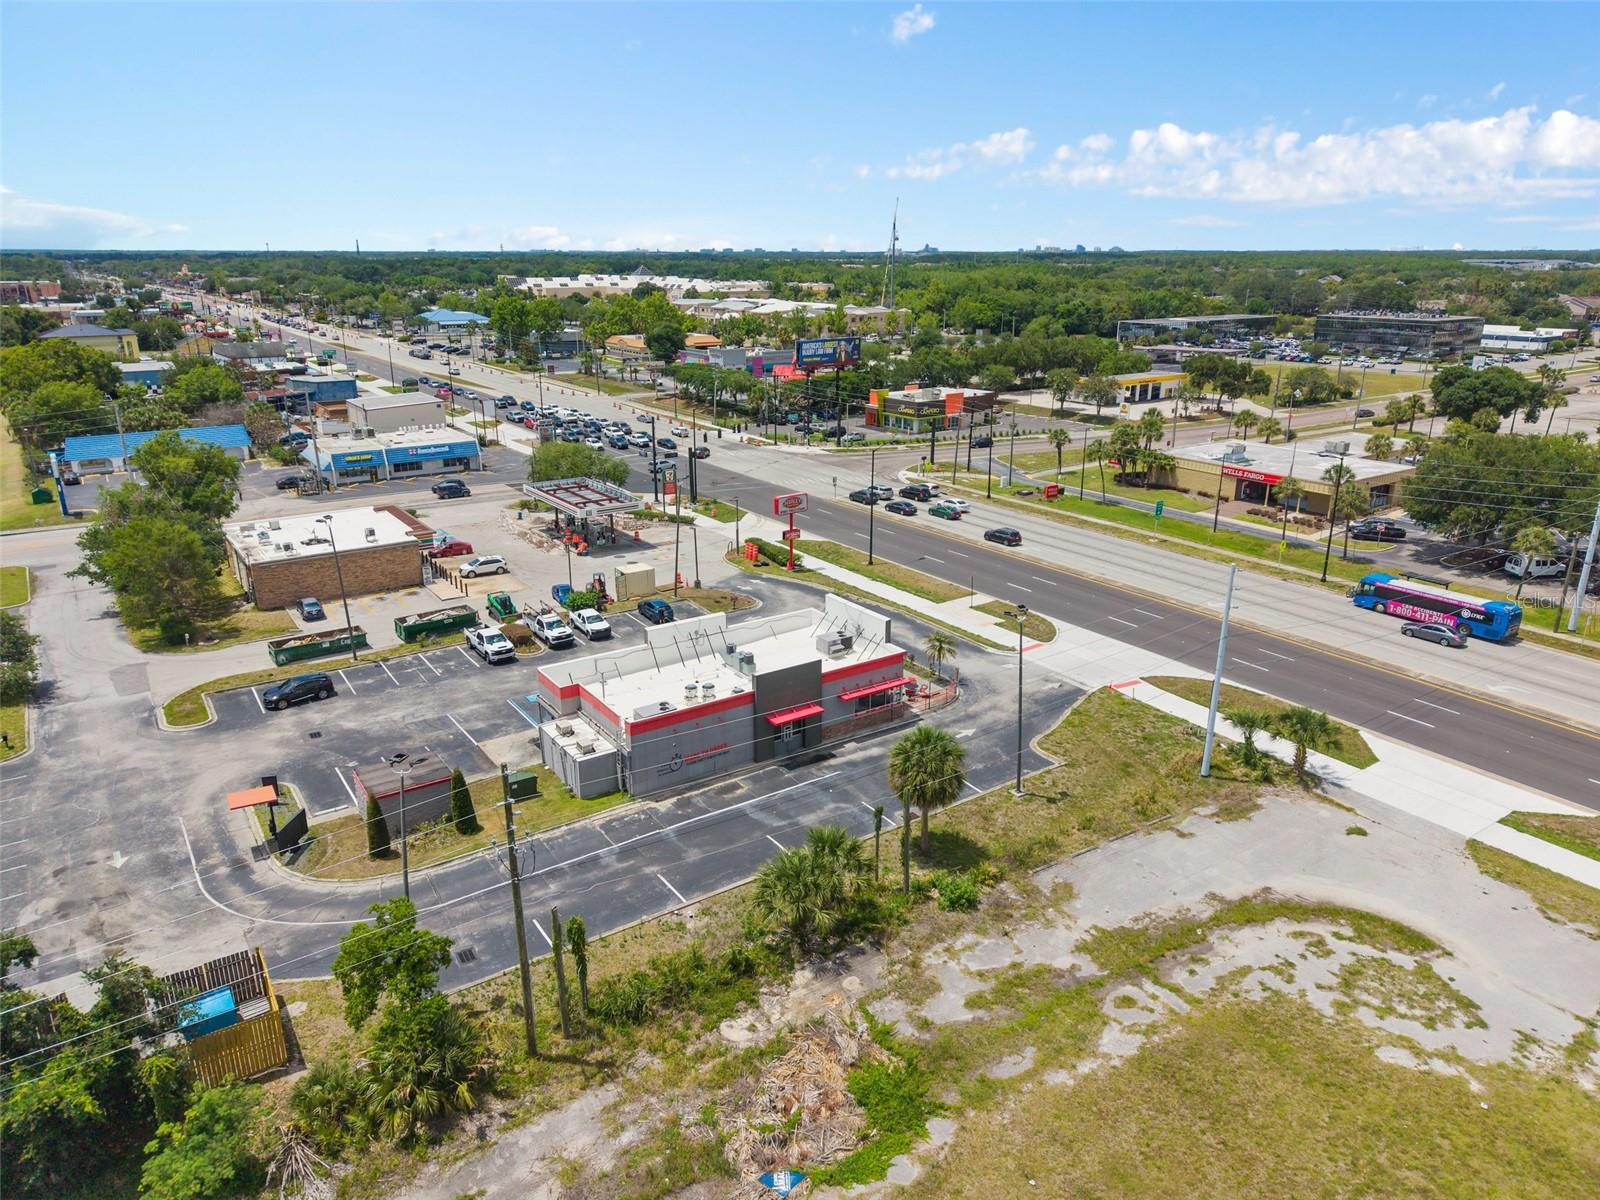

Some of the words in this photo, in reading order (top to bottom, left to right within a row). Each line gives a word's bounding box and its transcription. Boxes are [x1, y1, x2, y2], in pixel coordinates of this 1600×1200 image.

[1223, 468, 1243, 477] WELLS
[1243, 472, 1265, 481] FARGO
[1389, 604, 1454, 627] 1-800-411-PAIN
